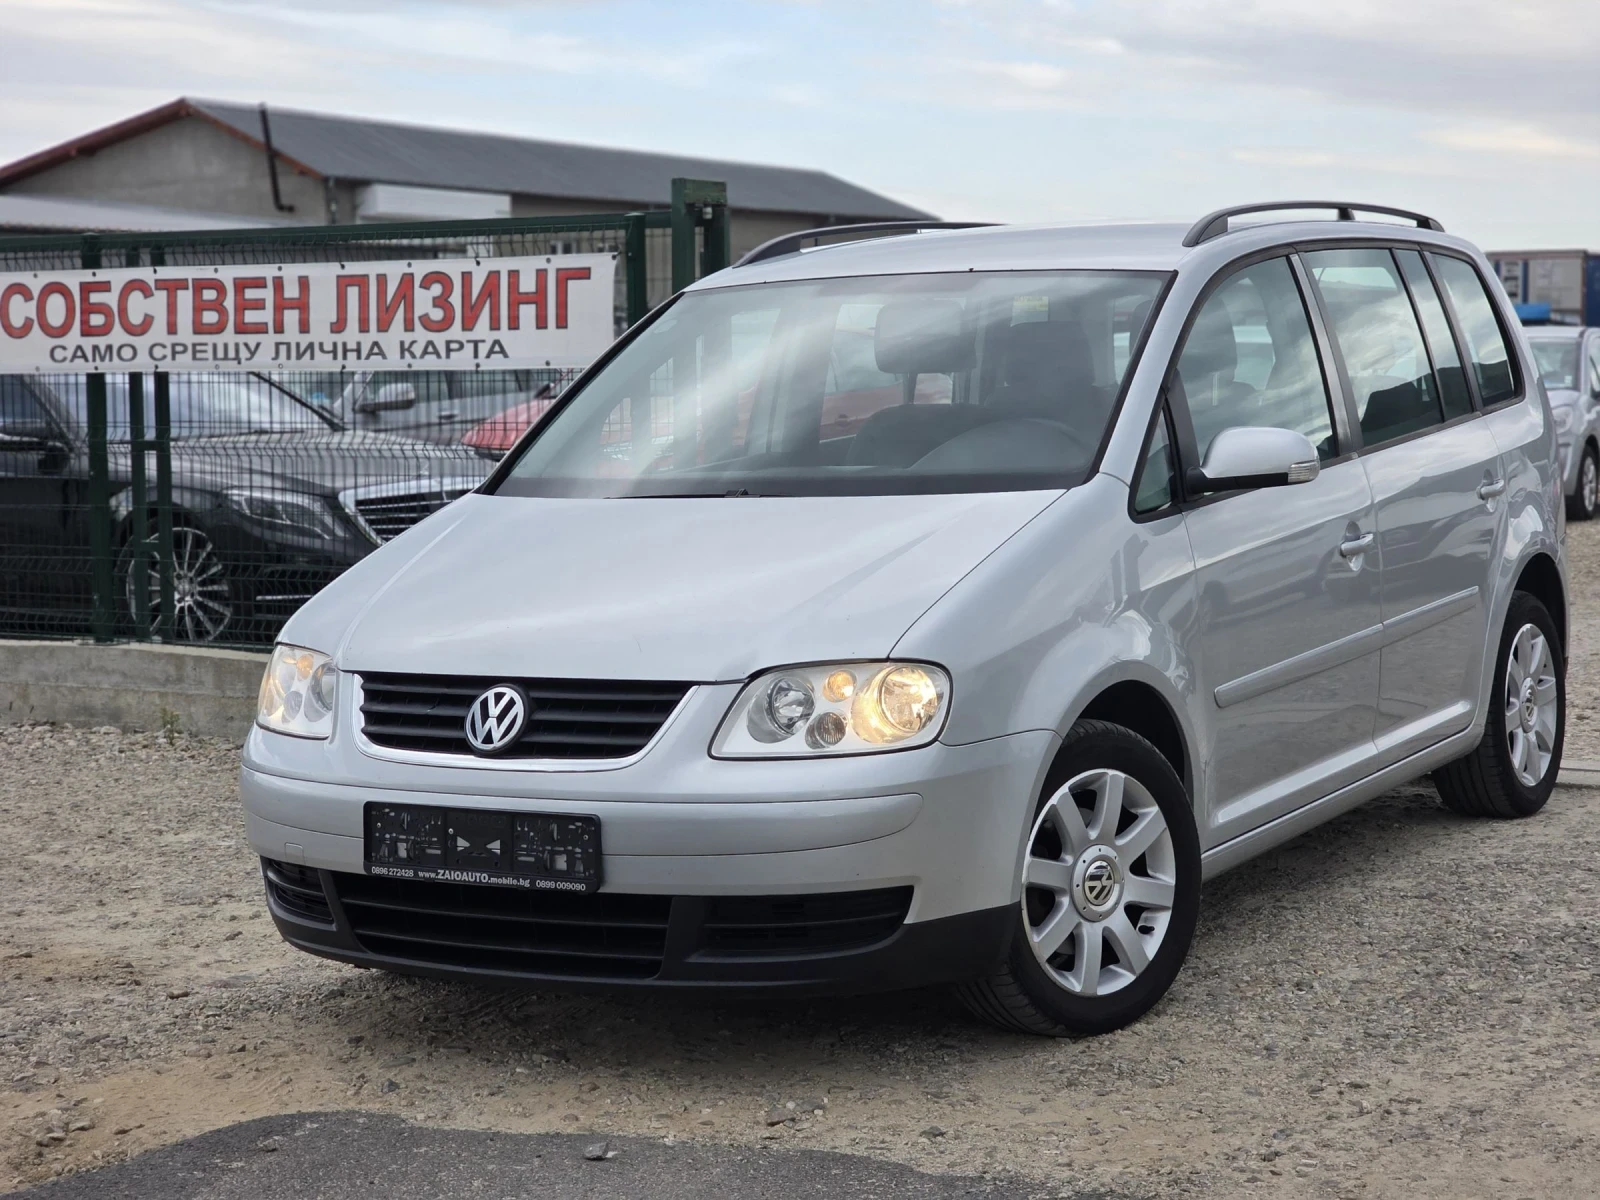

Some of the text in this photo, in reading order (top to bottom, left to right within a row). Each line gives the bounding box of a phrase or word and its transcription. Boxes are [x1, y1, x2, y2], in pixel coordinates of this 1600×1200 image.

[0, 267, 591, 339] СОБСТВЕН ЛИЗИНГ
[49, 339, 509, 364] САМО СРЕЩУ ЛИЧНА КАРТА
[371, 866, 389, 875] 0896
[388, 868, 414, 877] 272428
[535, 880, 556, 889] 0899
[556, 881, 586, 891] 009090
